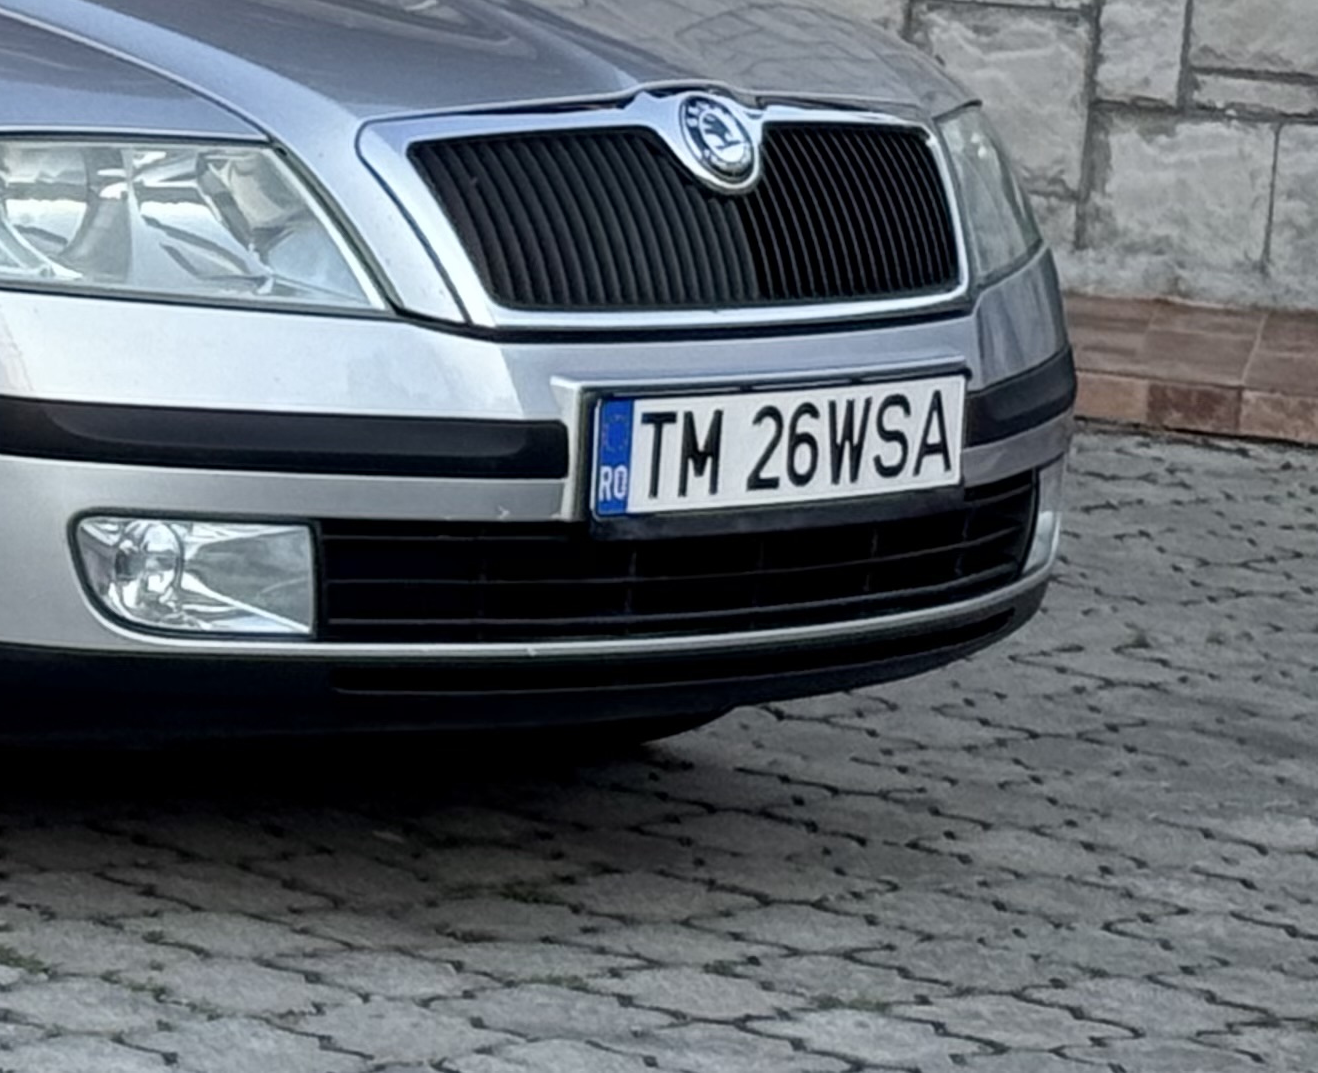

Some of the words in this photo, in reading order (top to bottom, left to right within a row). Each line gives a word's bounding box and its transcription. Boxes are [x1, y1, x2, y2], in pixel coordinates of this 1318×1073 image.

[641, 408, 724, 500] TM
[745, 388, 952, 492] 26WSA
[598, 465, 628, 502] RO
